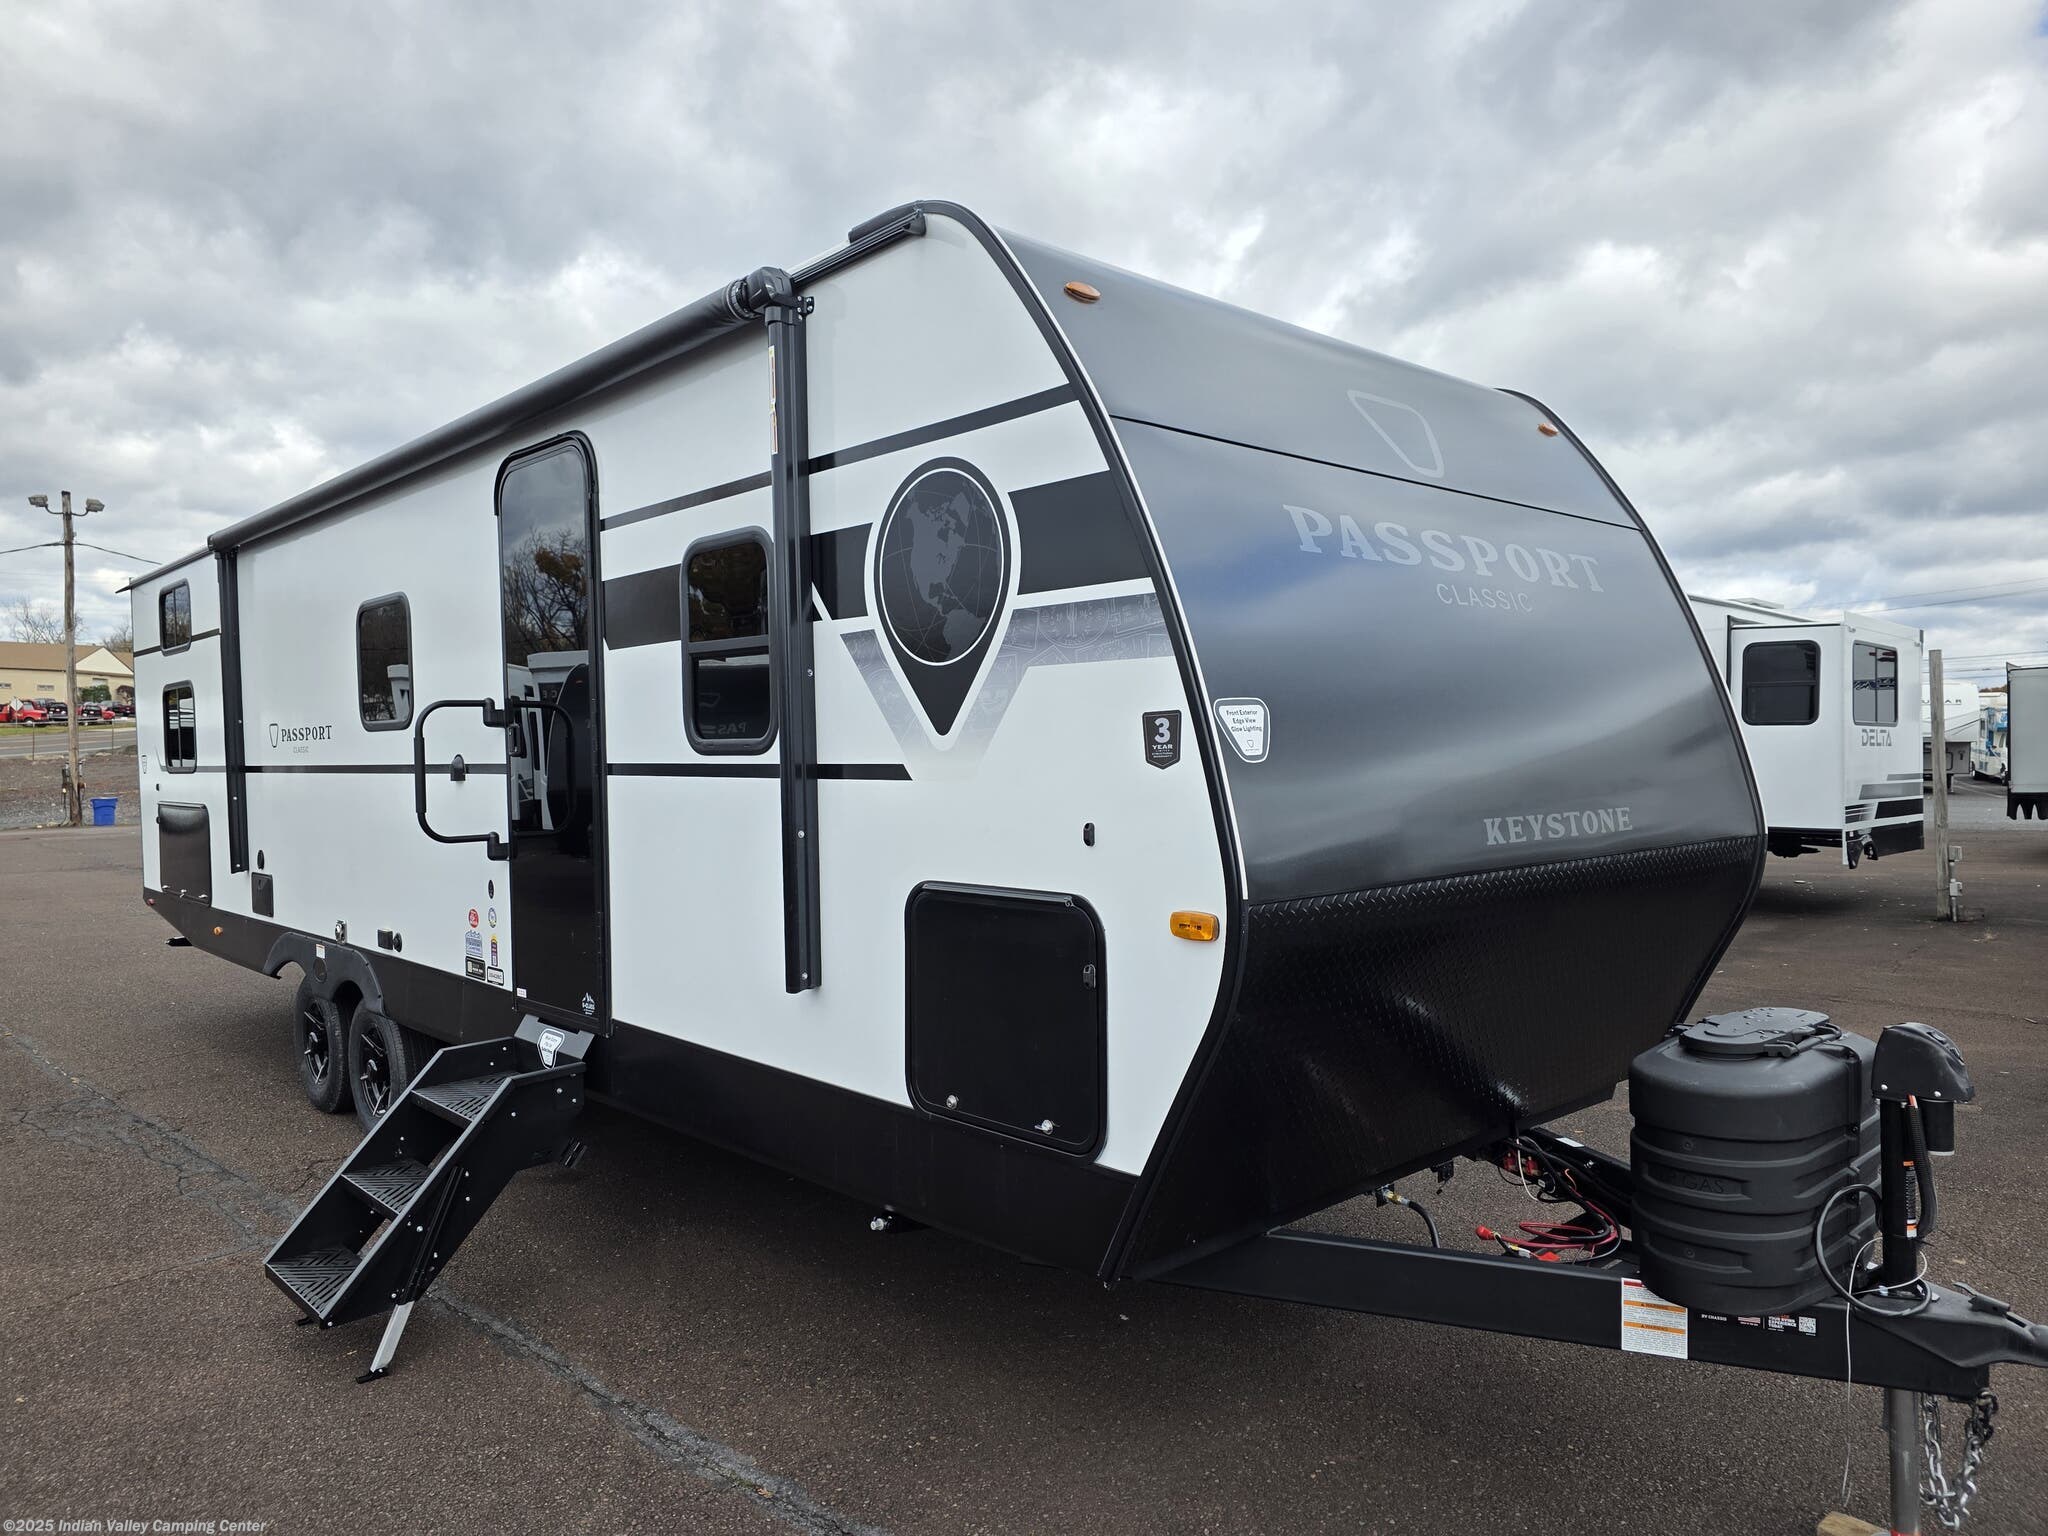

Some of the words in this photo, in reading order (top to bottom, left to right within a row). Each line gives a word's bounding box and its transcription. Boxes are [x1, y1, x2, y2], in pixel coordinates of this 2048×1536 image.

[1283, 504, 1604, 592] PASSPORT
[1436, 583, 1533, 612] CLASSIC
[281, 725, 332, 742] PASSPORT
[1154, 717, 1170, 743] 3
[1861, 728, 1892, 746] DELTA
[1483, 807, 1633, 846] KEYSTONE
